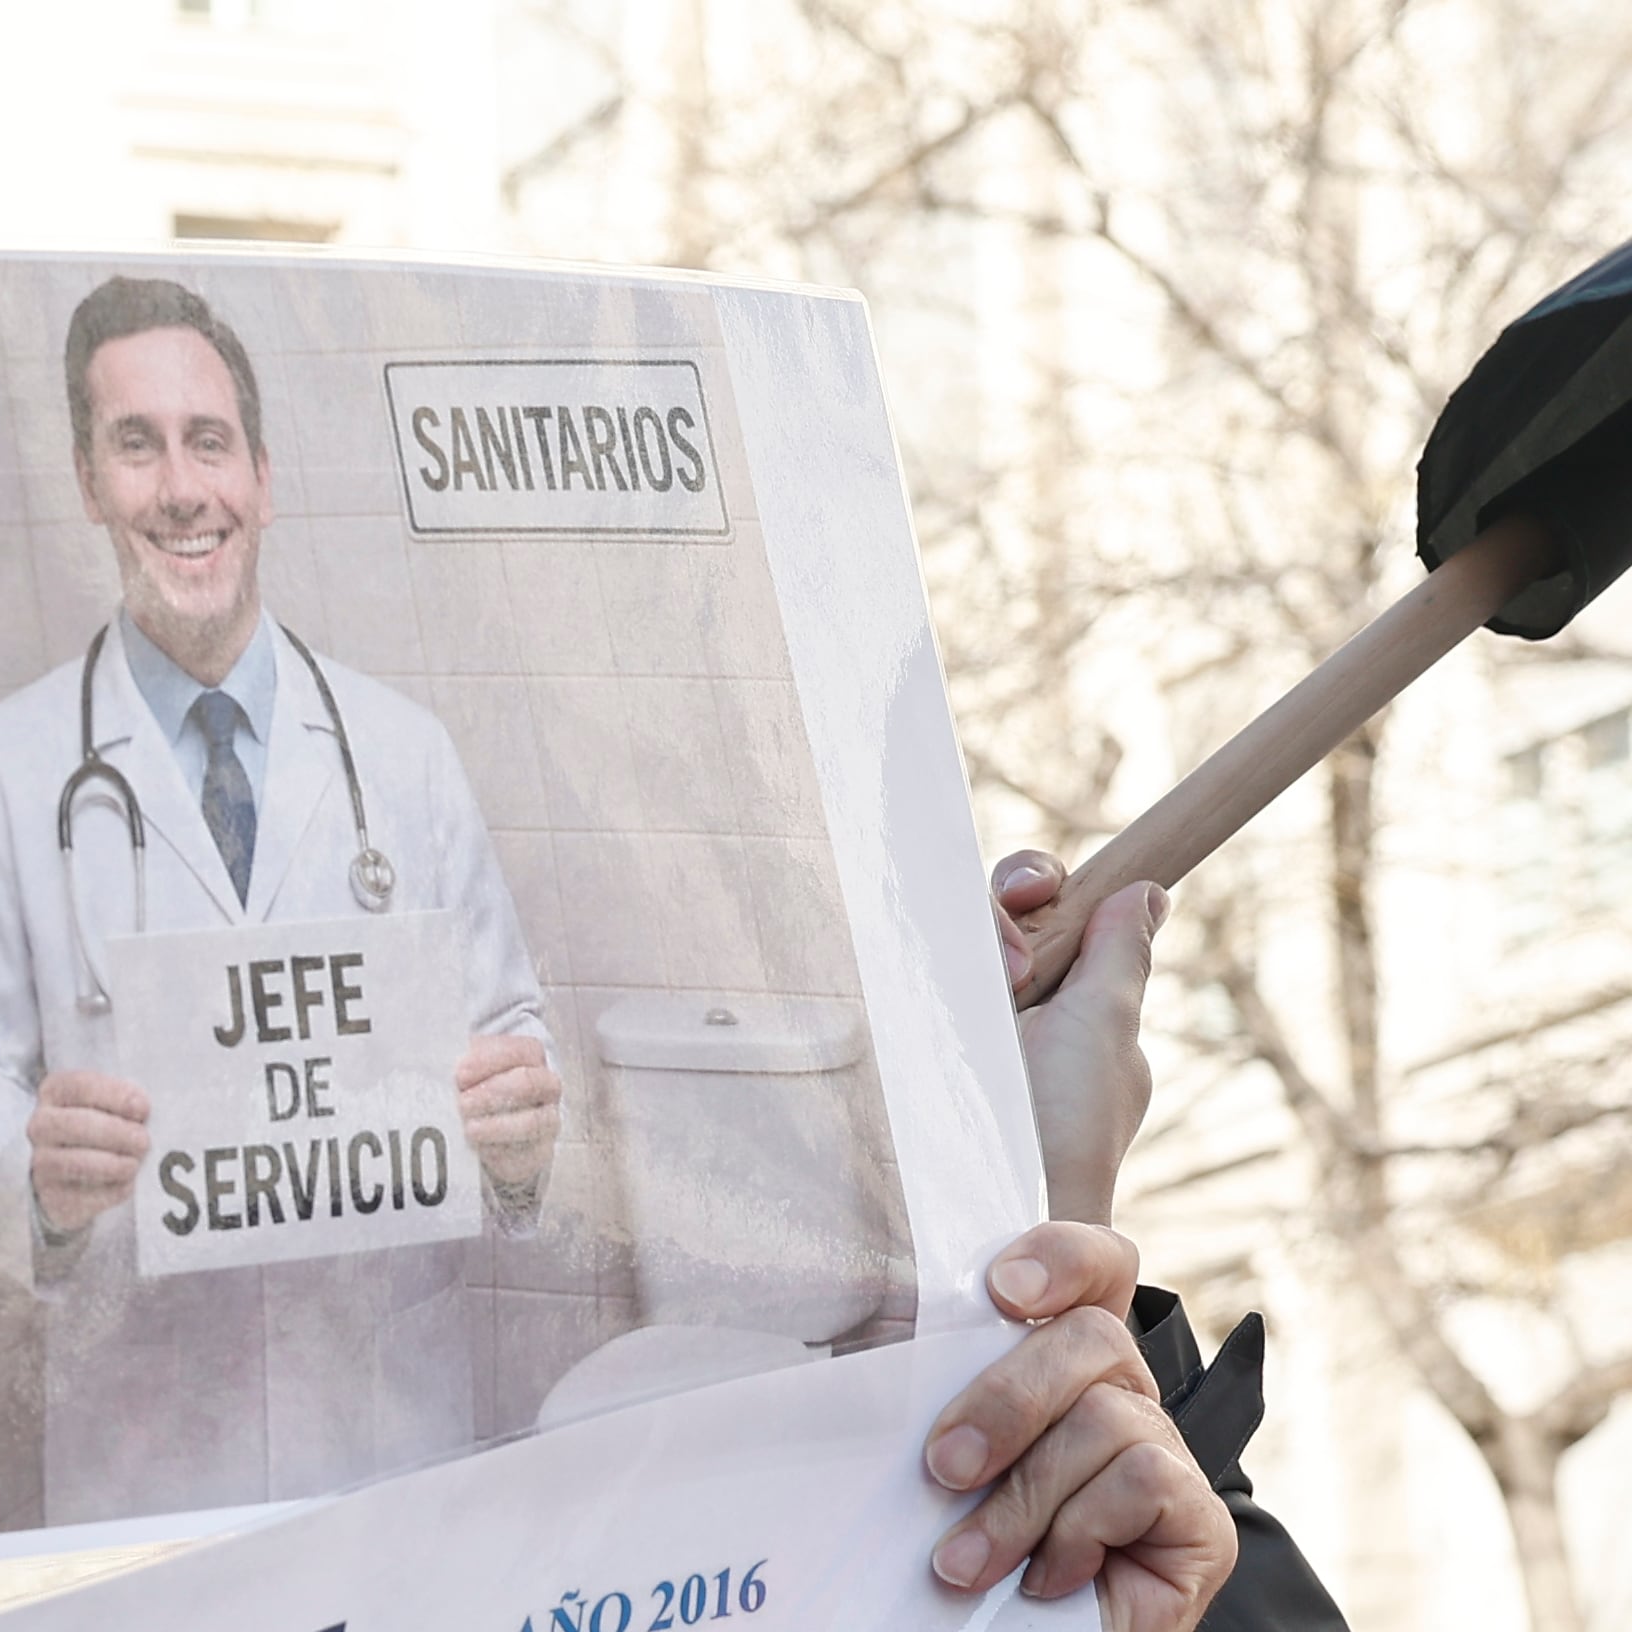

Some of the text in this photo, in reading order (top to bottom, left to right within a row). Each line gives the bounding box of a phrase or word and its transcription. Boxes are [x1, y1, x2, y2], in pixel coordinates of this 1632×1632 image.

[412, 405, 706, 493] SANITARIOS
[213, 953, 372, 1048] JEFE
[264, 1057, 335, 1122] DE
[158, 1126, 448, 1236] SERVICIO
[647, 1559, 768, 1632] 2016
